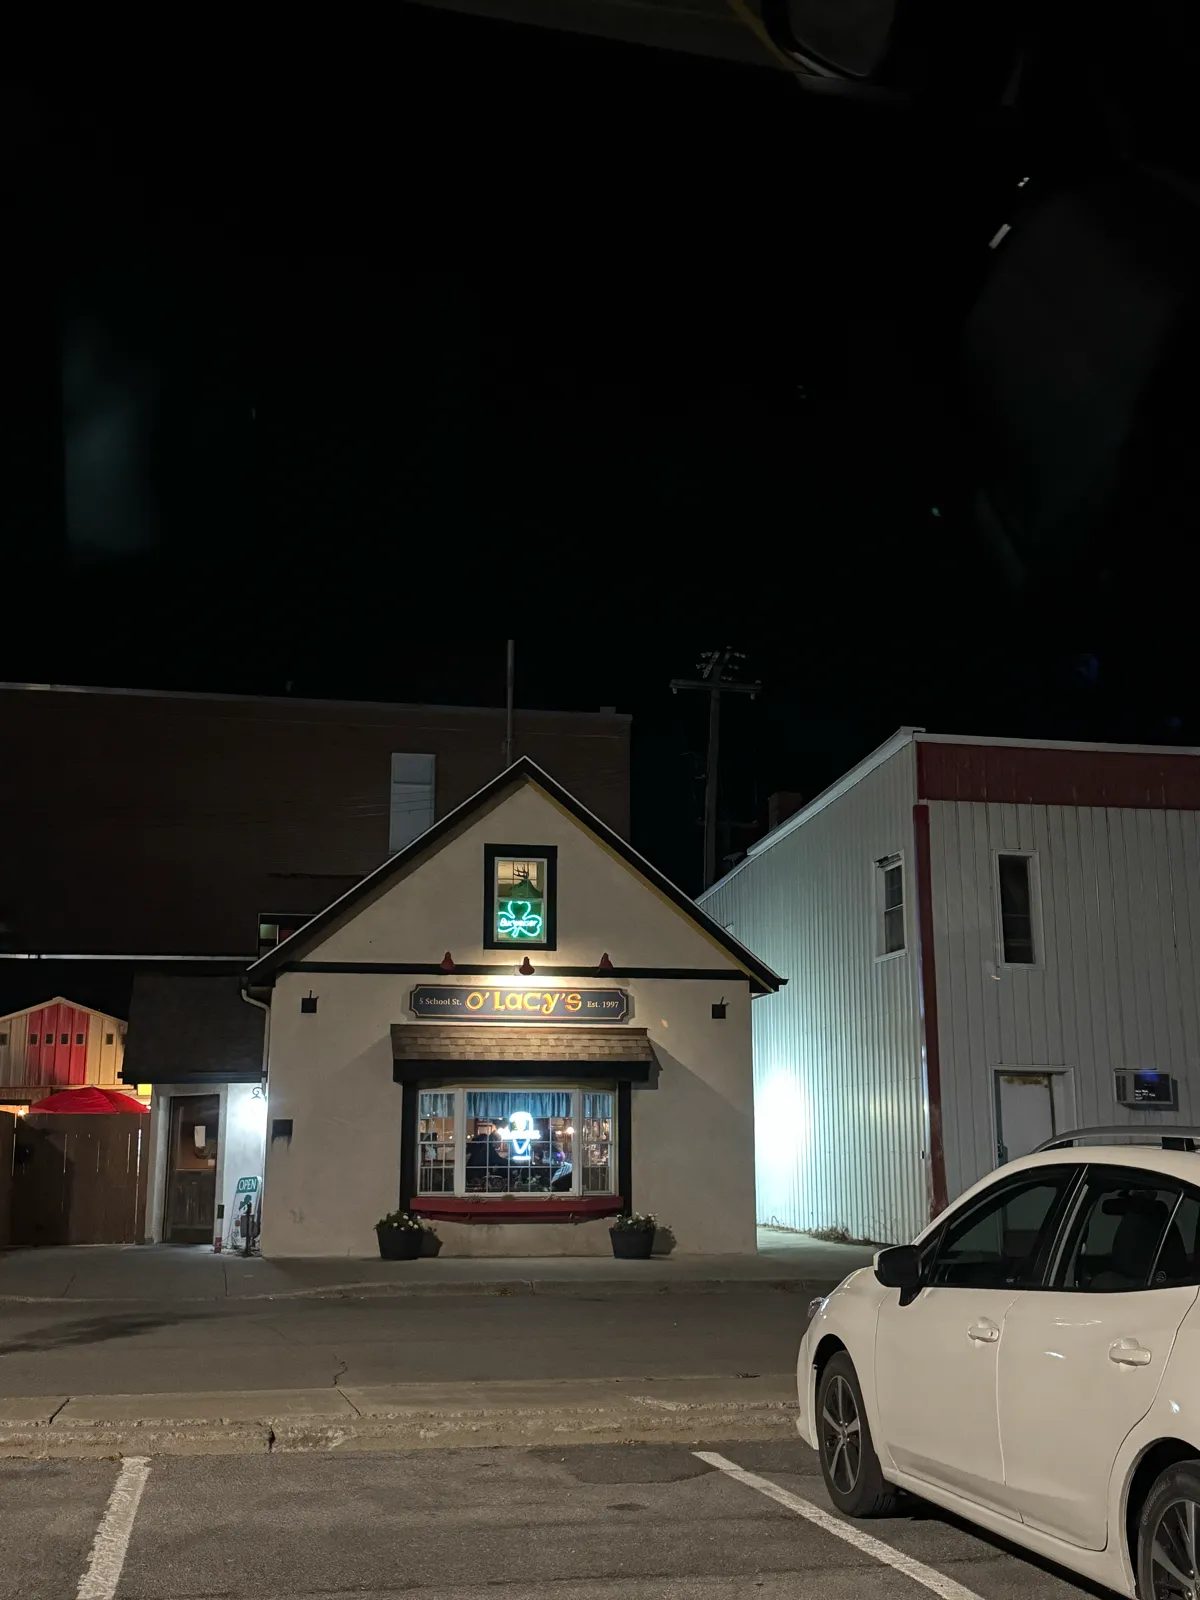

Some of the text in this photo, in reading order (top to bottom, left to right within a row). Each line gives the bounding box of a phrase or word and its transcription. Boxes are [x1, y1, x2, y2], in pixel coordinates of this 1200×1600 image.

[425, 997, 450, 1006] School
[451, 998, 462, 1006] St.
[602, 1000, 619, 1008] 1997
[238, 1178, 257, 1190] OPEN
